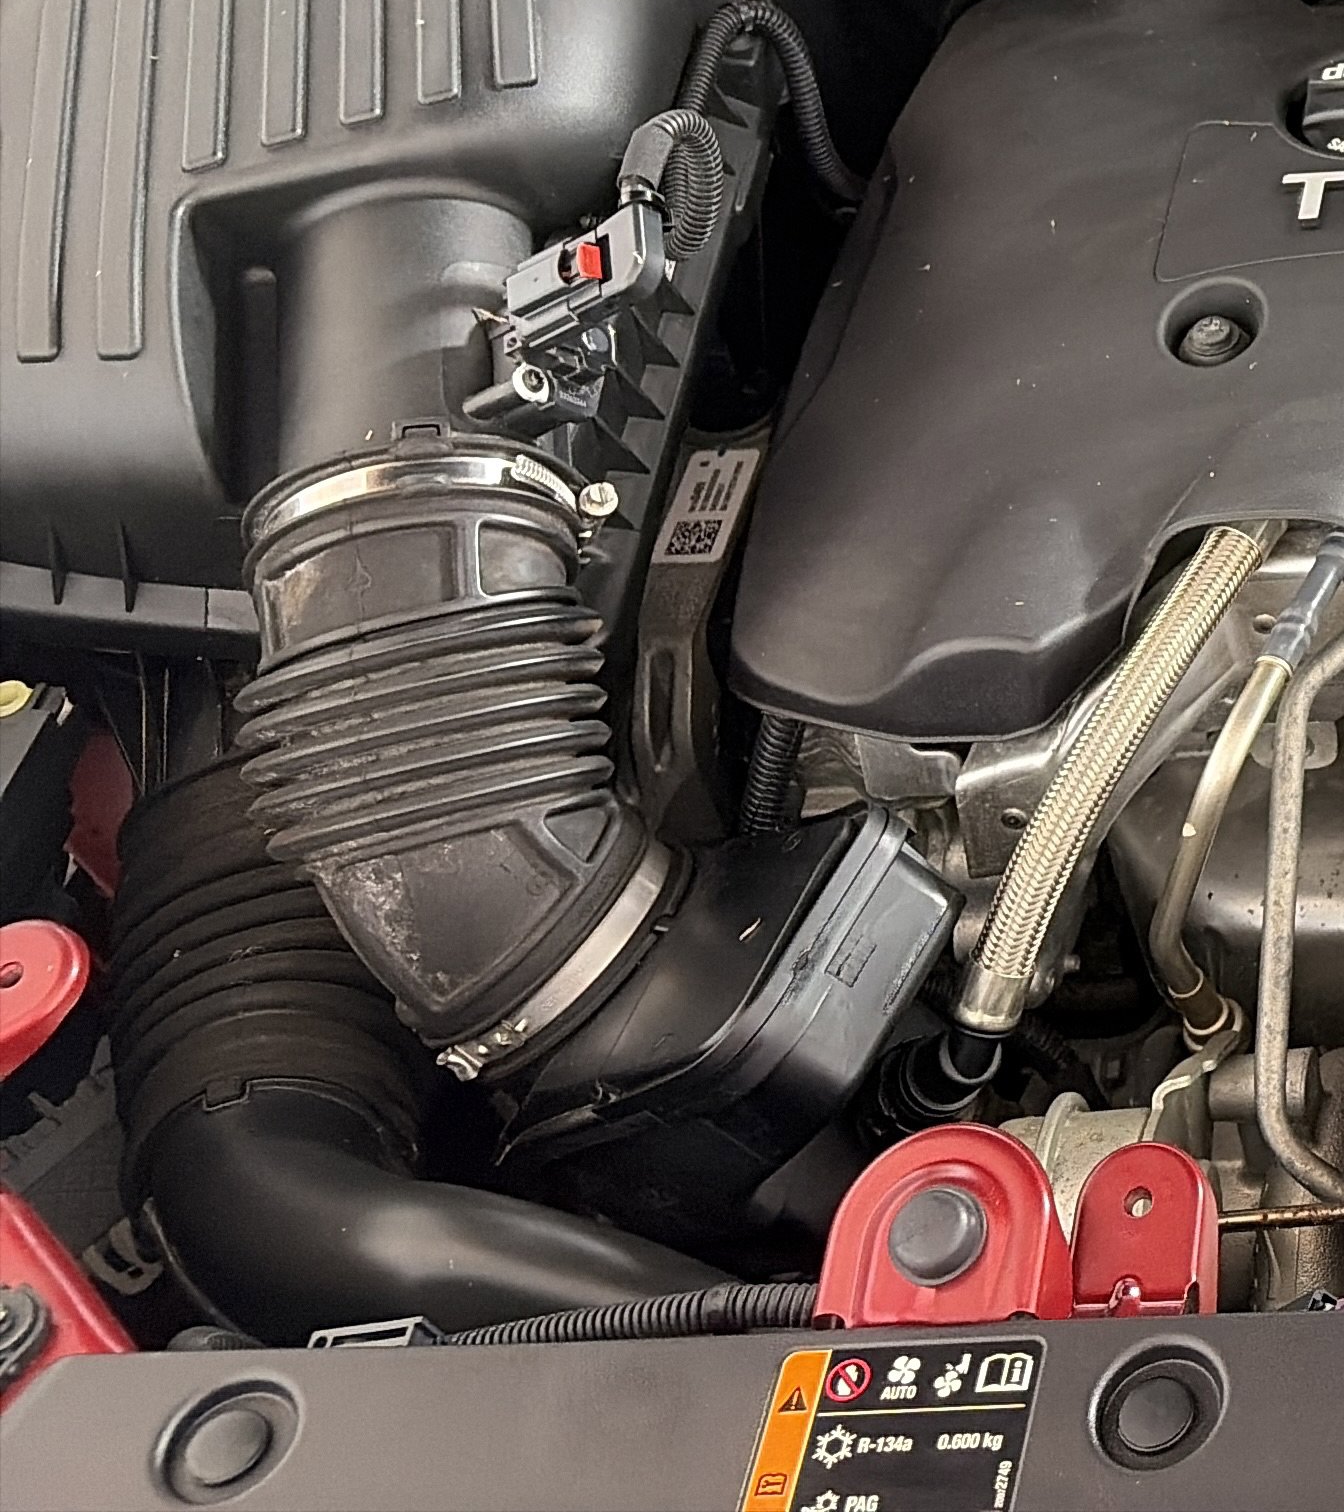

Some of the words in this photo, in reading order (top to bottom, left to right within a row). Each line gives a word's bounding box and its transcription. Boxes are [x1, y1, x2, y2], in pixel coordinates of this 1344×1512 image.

[880, 1384, 918, 1401] AUTO
[856, 1436, 914, 1454] R-134a
[936, 1433, 979, 1451] 0.600
[981, 1432, 1005, 1452] kg
[843, 1494, 880, 1512] PAG
